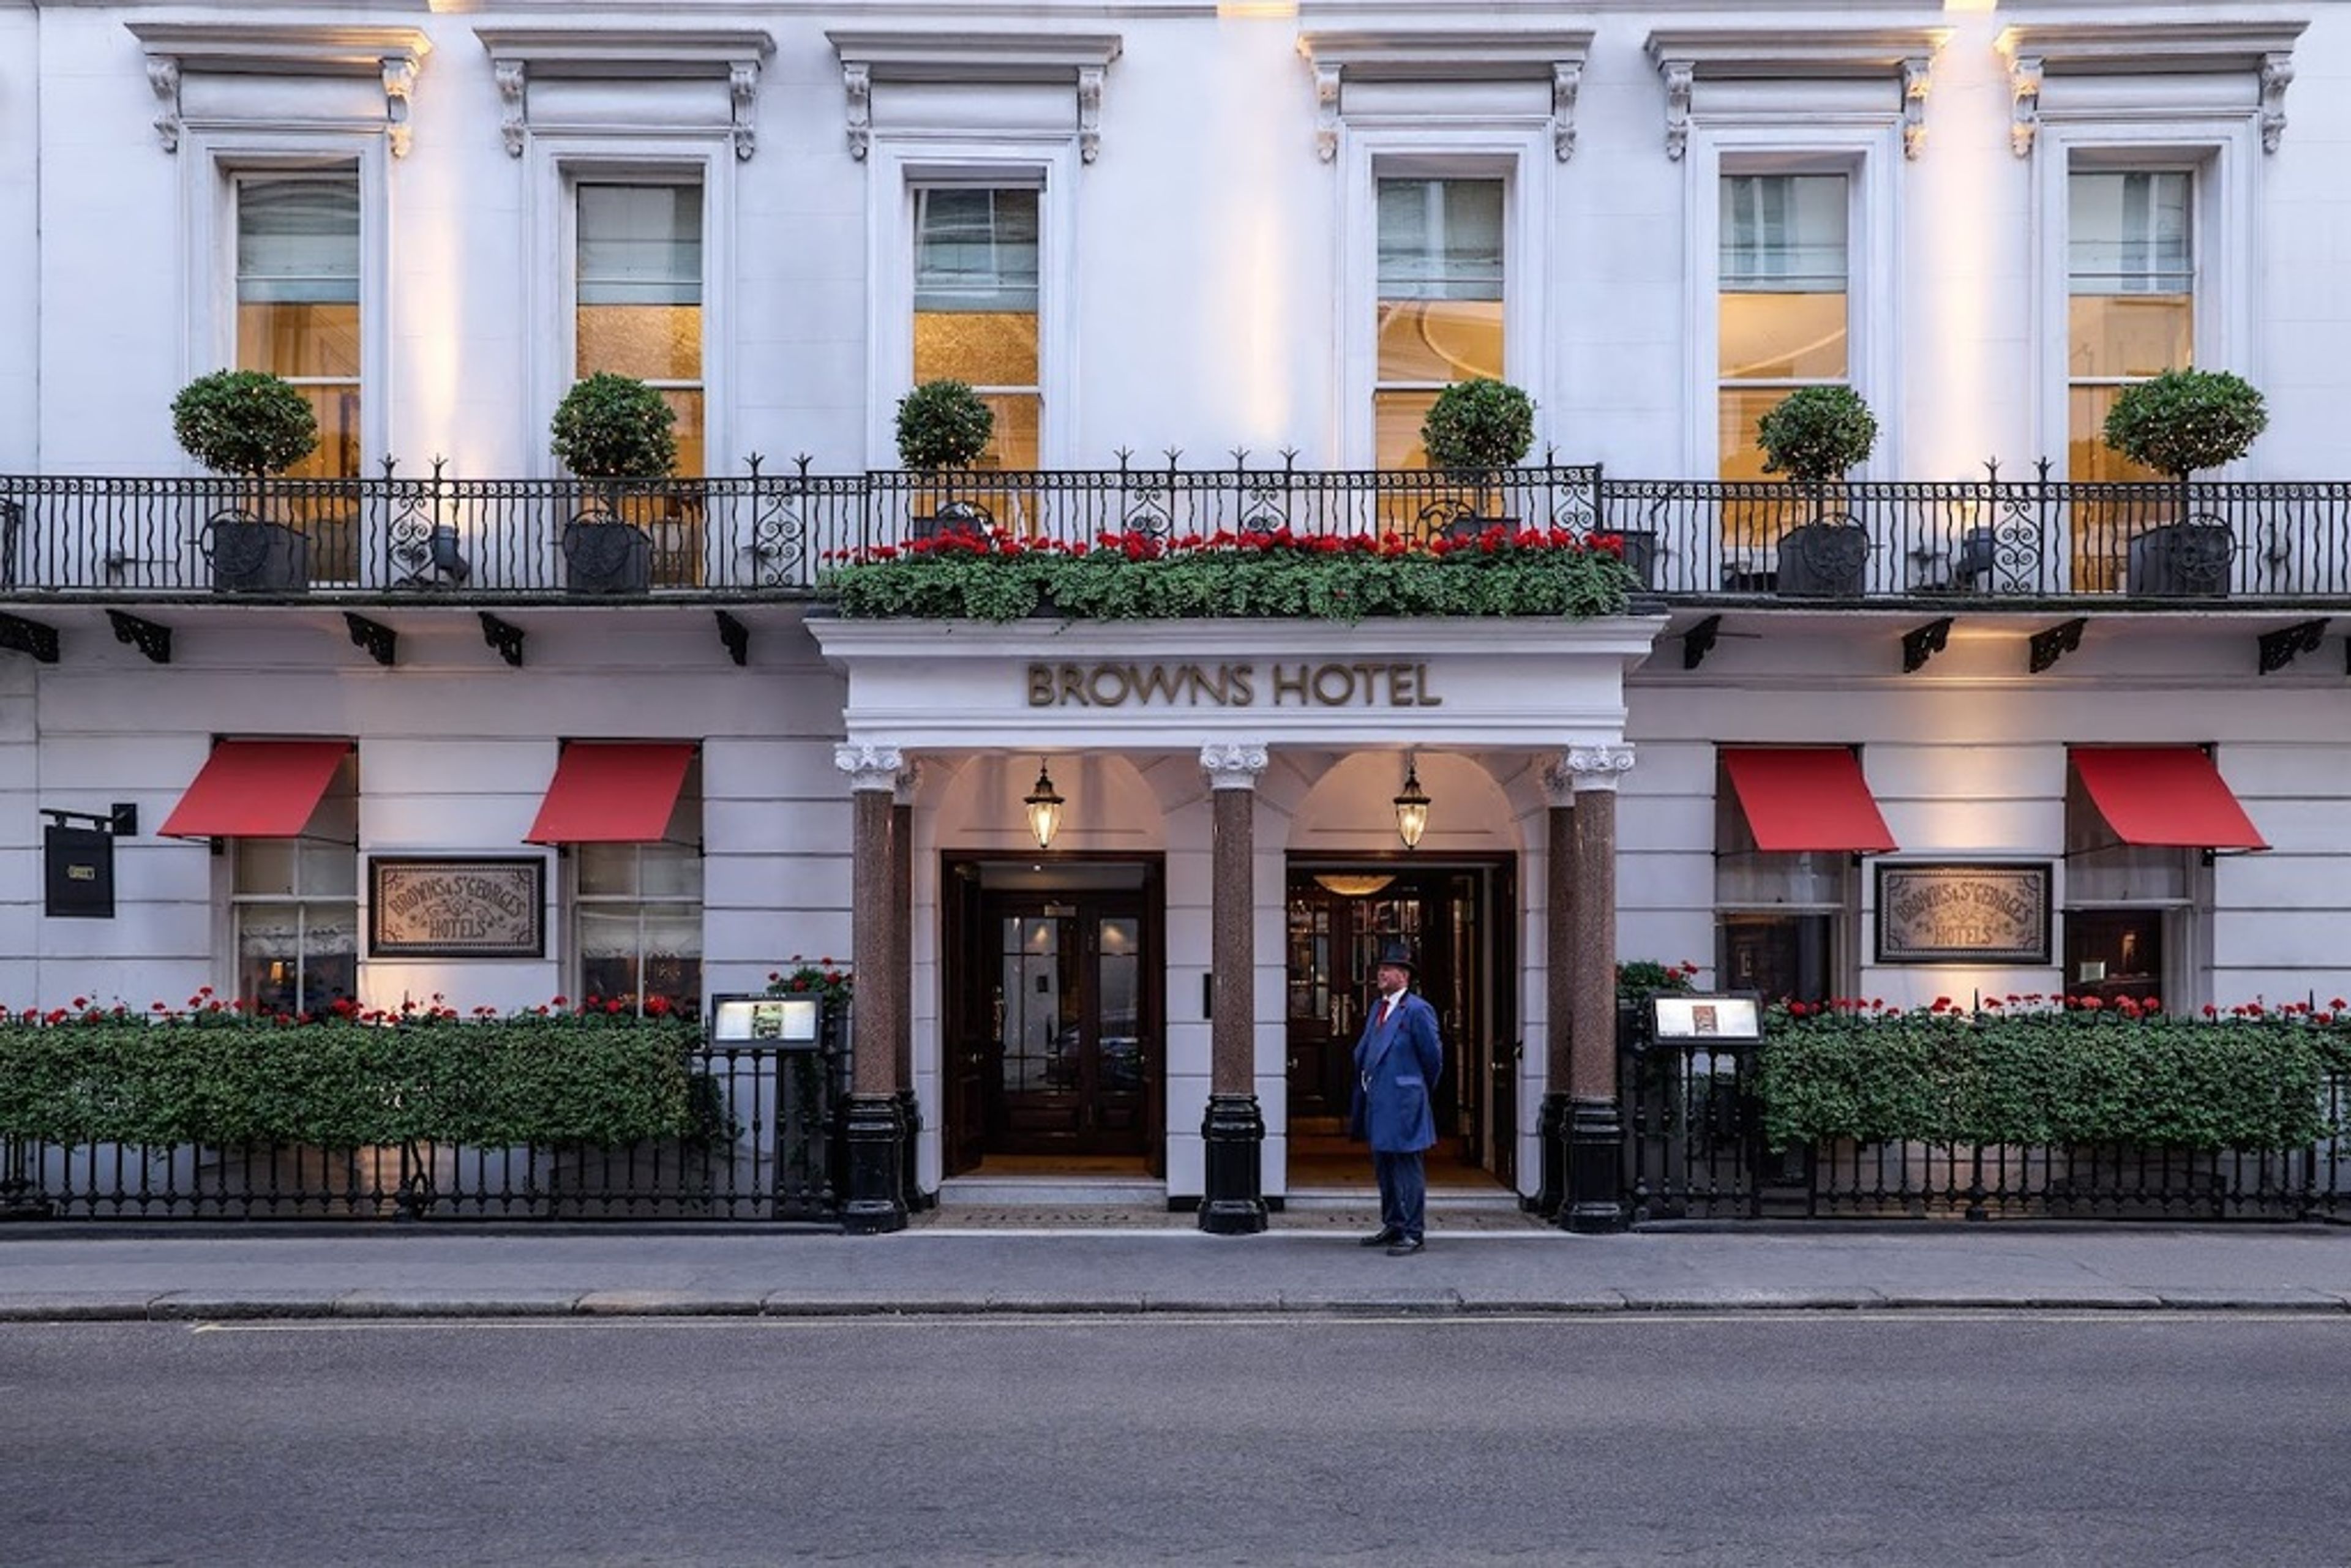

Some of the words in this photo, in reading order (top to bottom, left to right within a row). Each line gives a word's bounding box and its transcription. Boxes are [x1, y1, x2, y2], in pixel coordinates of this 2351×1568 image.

[1028, 663, 1254, 707] BROWNS
[1272, 663, 1442, 707] HOTEL
[388, 877, 445, 917] BROWNS
[429, 918, 487, 939] HOTELS
[1933, 925, 1993, 945] HOTELS
